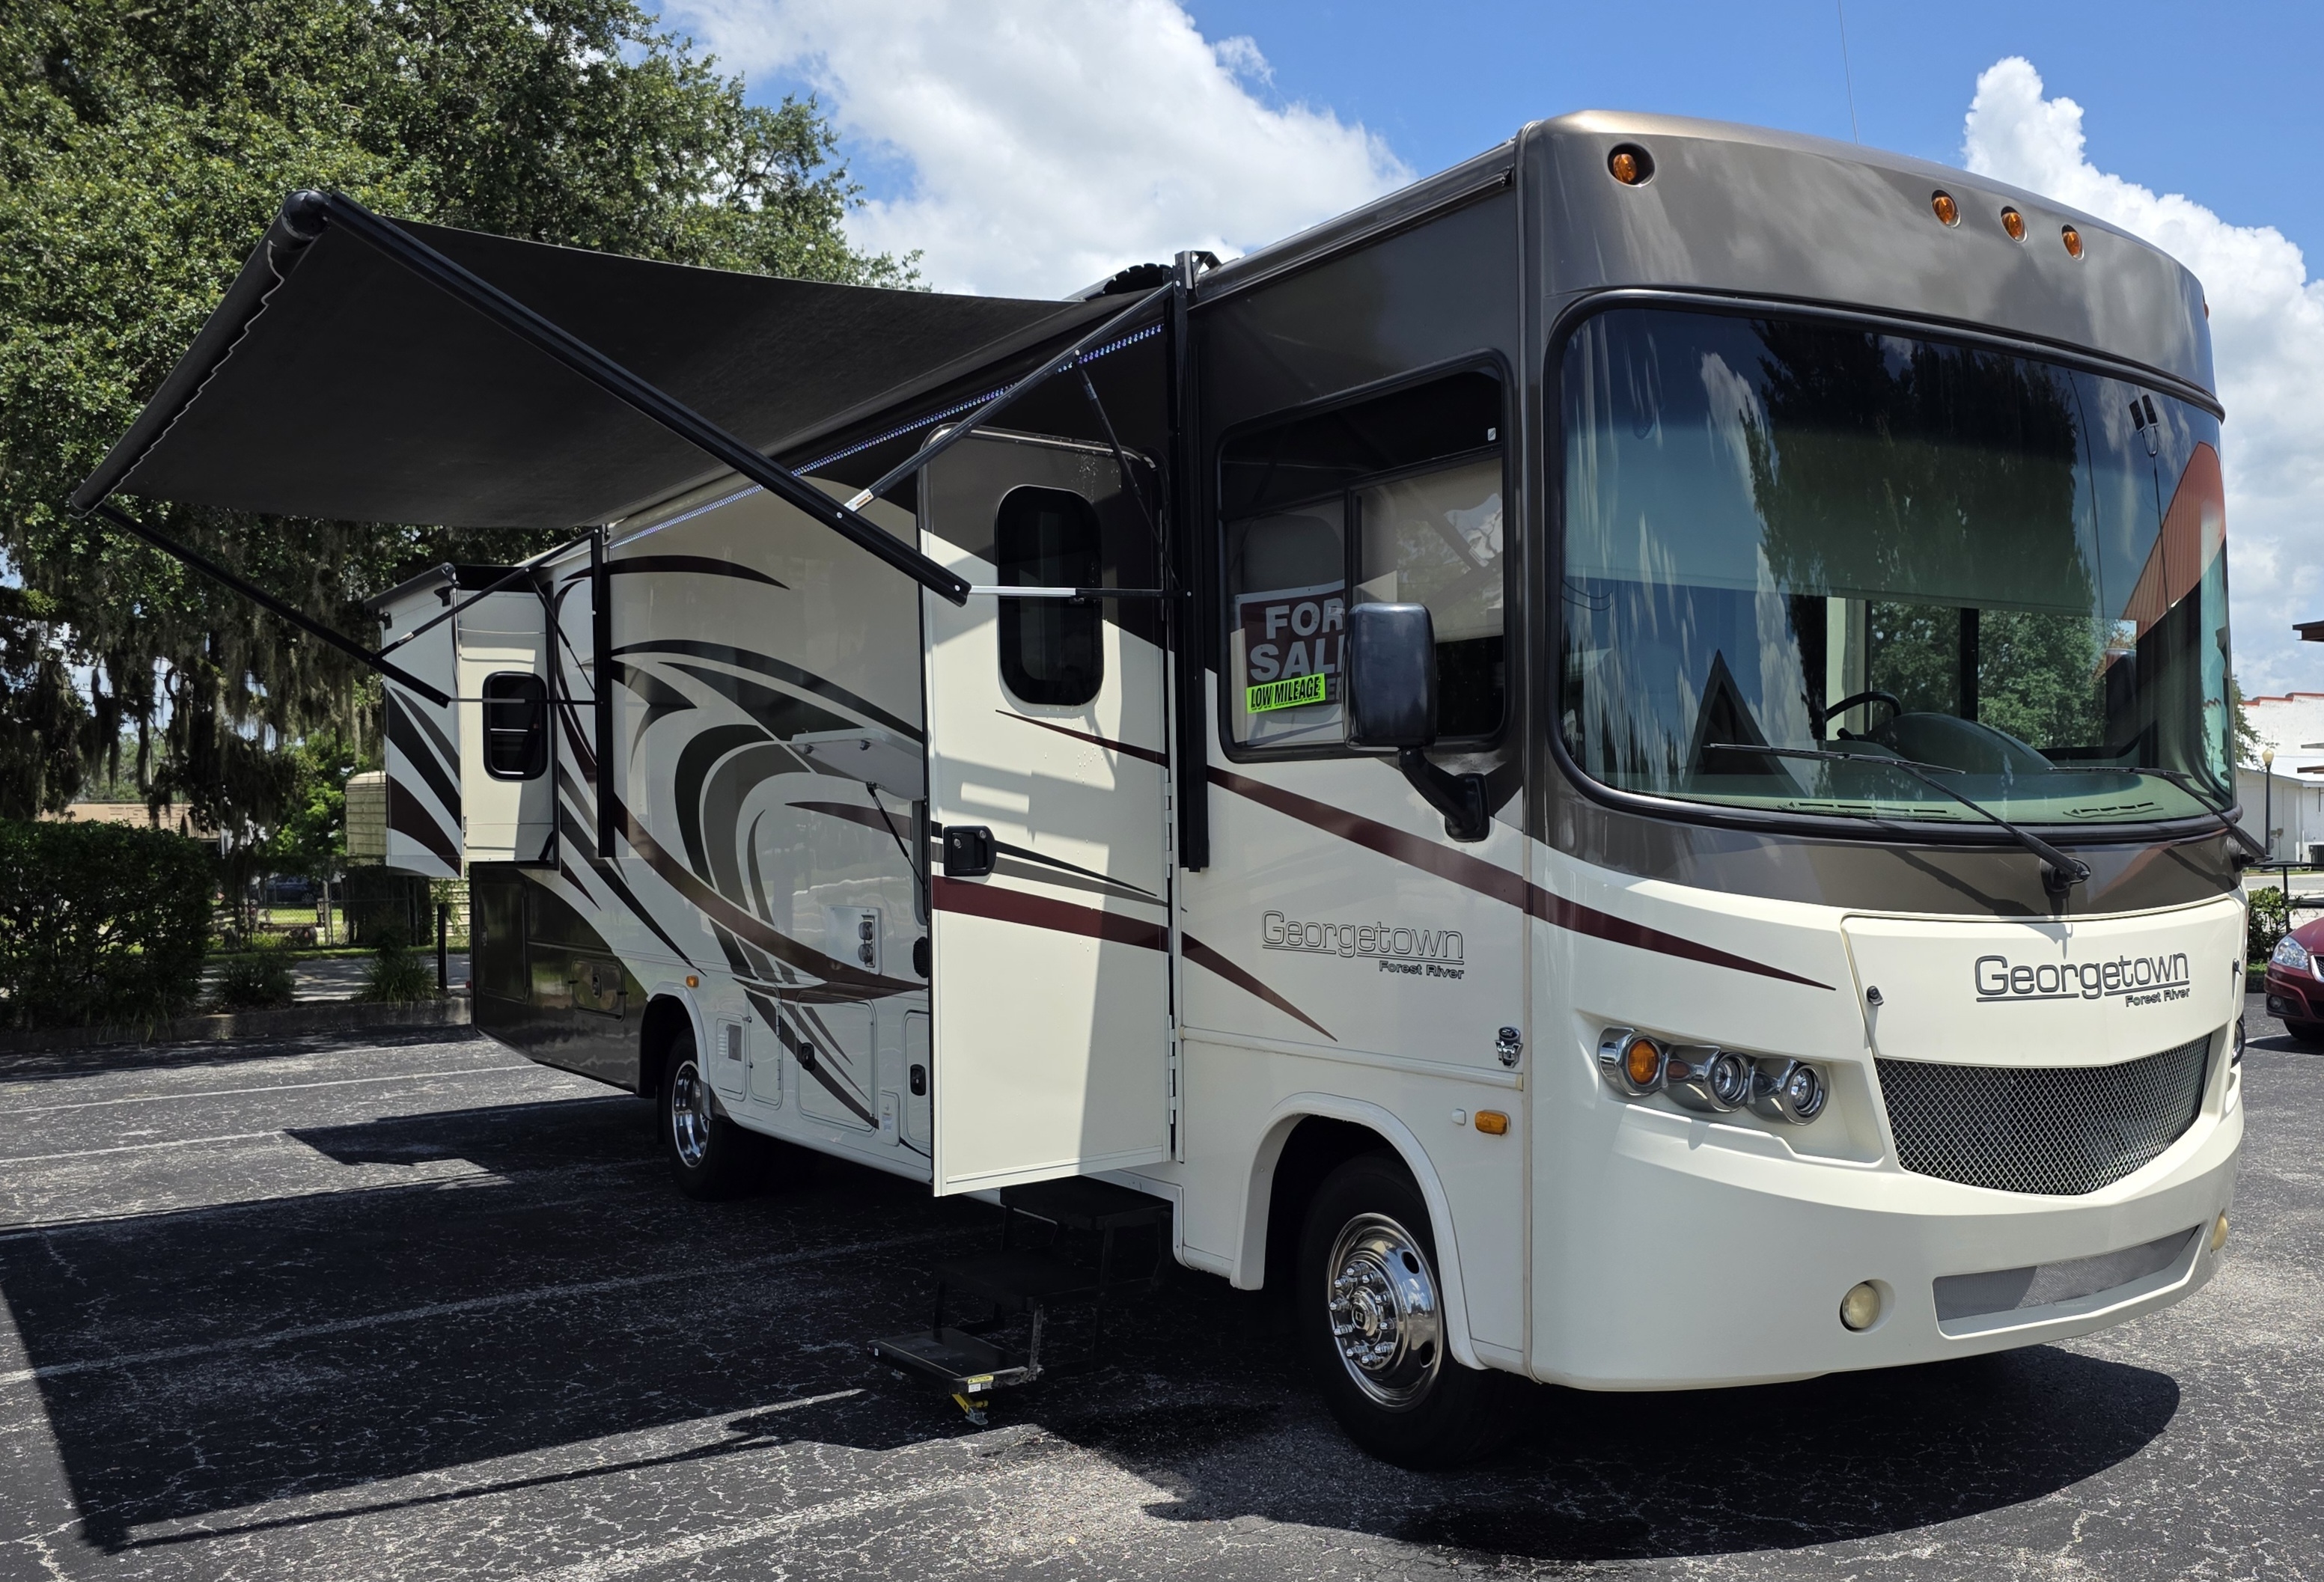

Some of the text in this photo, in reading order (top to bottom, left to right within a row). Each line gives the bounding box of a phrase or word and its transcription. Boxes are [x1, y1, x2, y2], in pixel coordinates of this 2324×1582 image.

[1266, 598, 1345, 640] FOR
[1251, 685, 1272, 710] LOW
[1274, 676, 1321, 706] MILEAGE
[1262, 910, 1463, 959] Georgetown
[1379, 960, 1464, 980] Forest River
[1974, 953, 2189, 999] Georgetown
[2125, 988, 2190, 1007] Forest River
